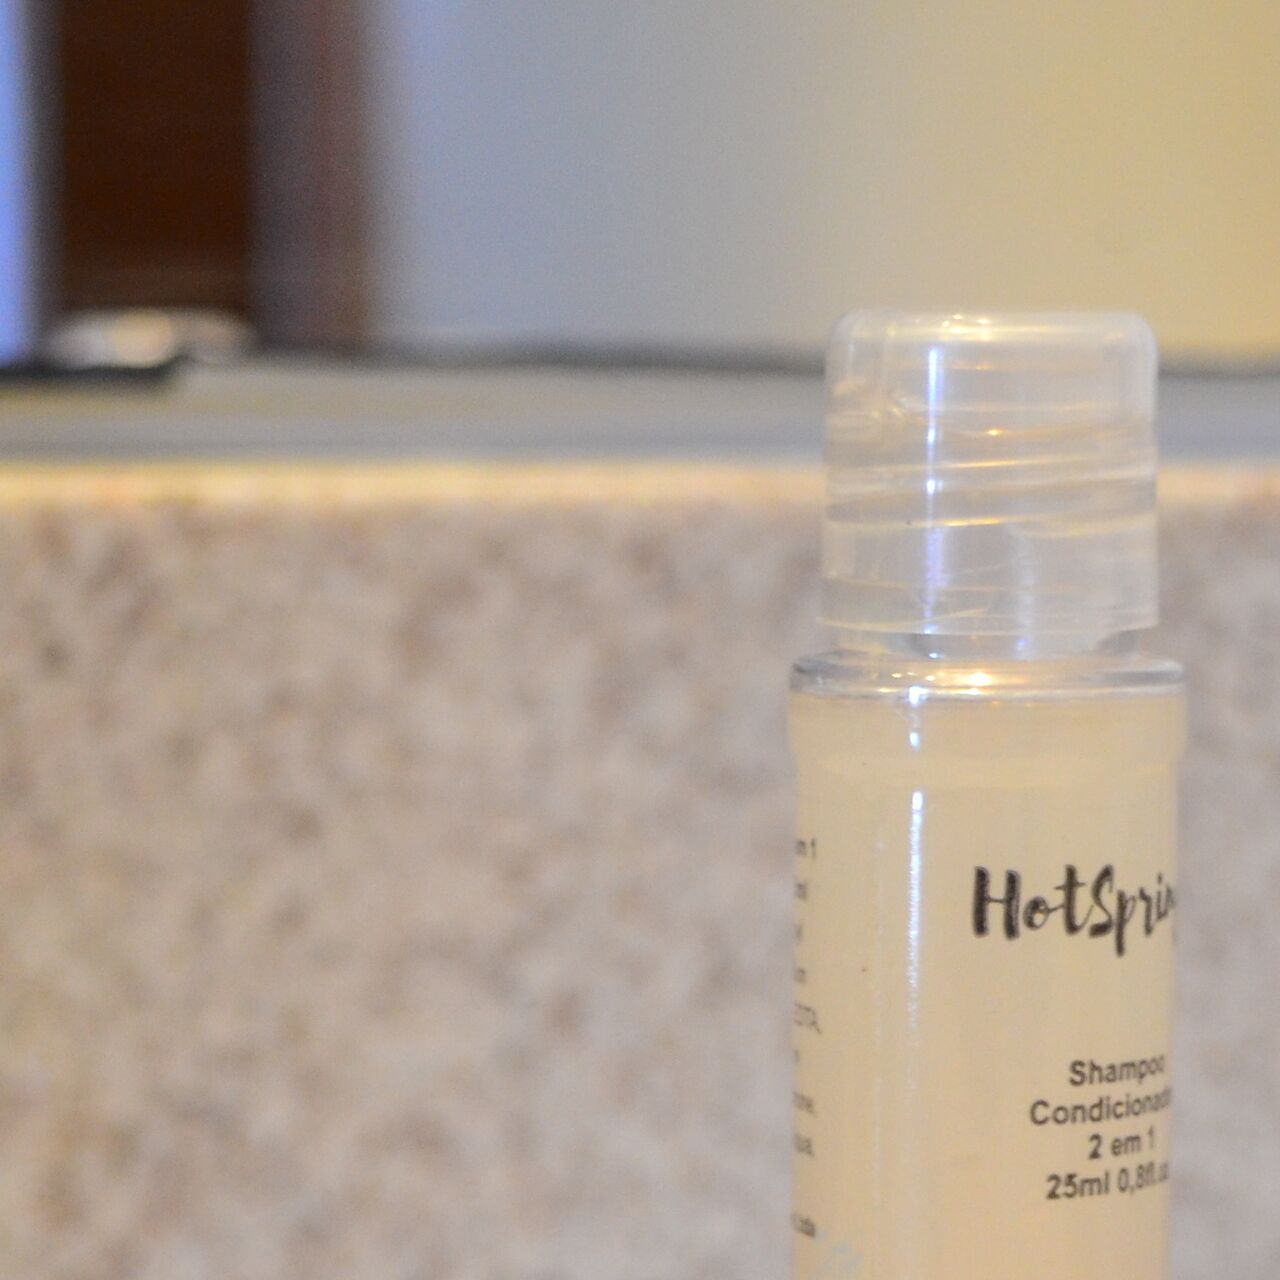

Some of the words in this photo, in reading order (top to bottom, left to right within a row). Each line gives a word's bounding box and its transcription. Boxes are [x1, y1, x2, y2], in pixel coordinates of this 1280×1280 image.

[1088, 1133, 1103, 1160] 2
[1110, 1135, 1141, 1156] em
[1147, 1125, 1155, 1150] 1
[1046, 1171, 1110, 1200] 25ml
